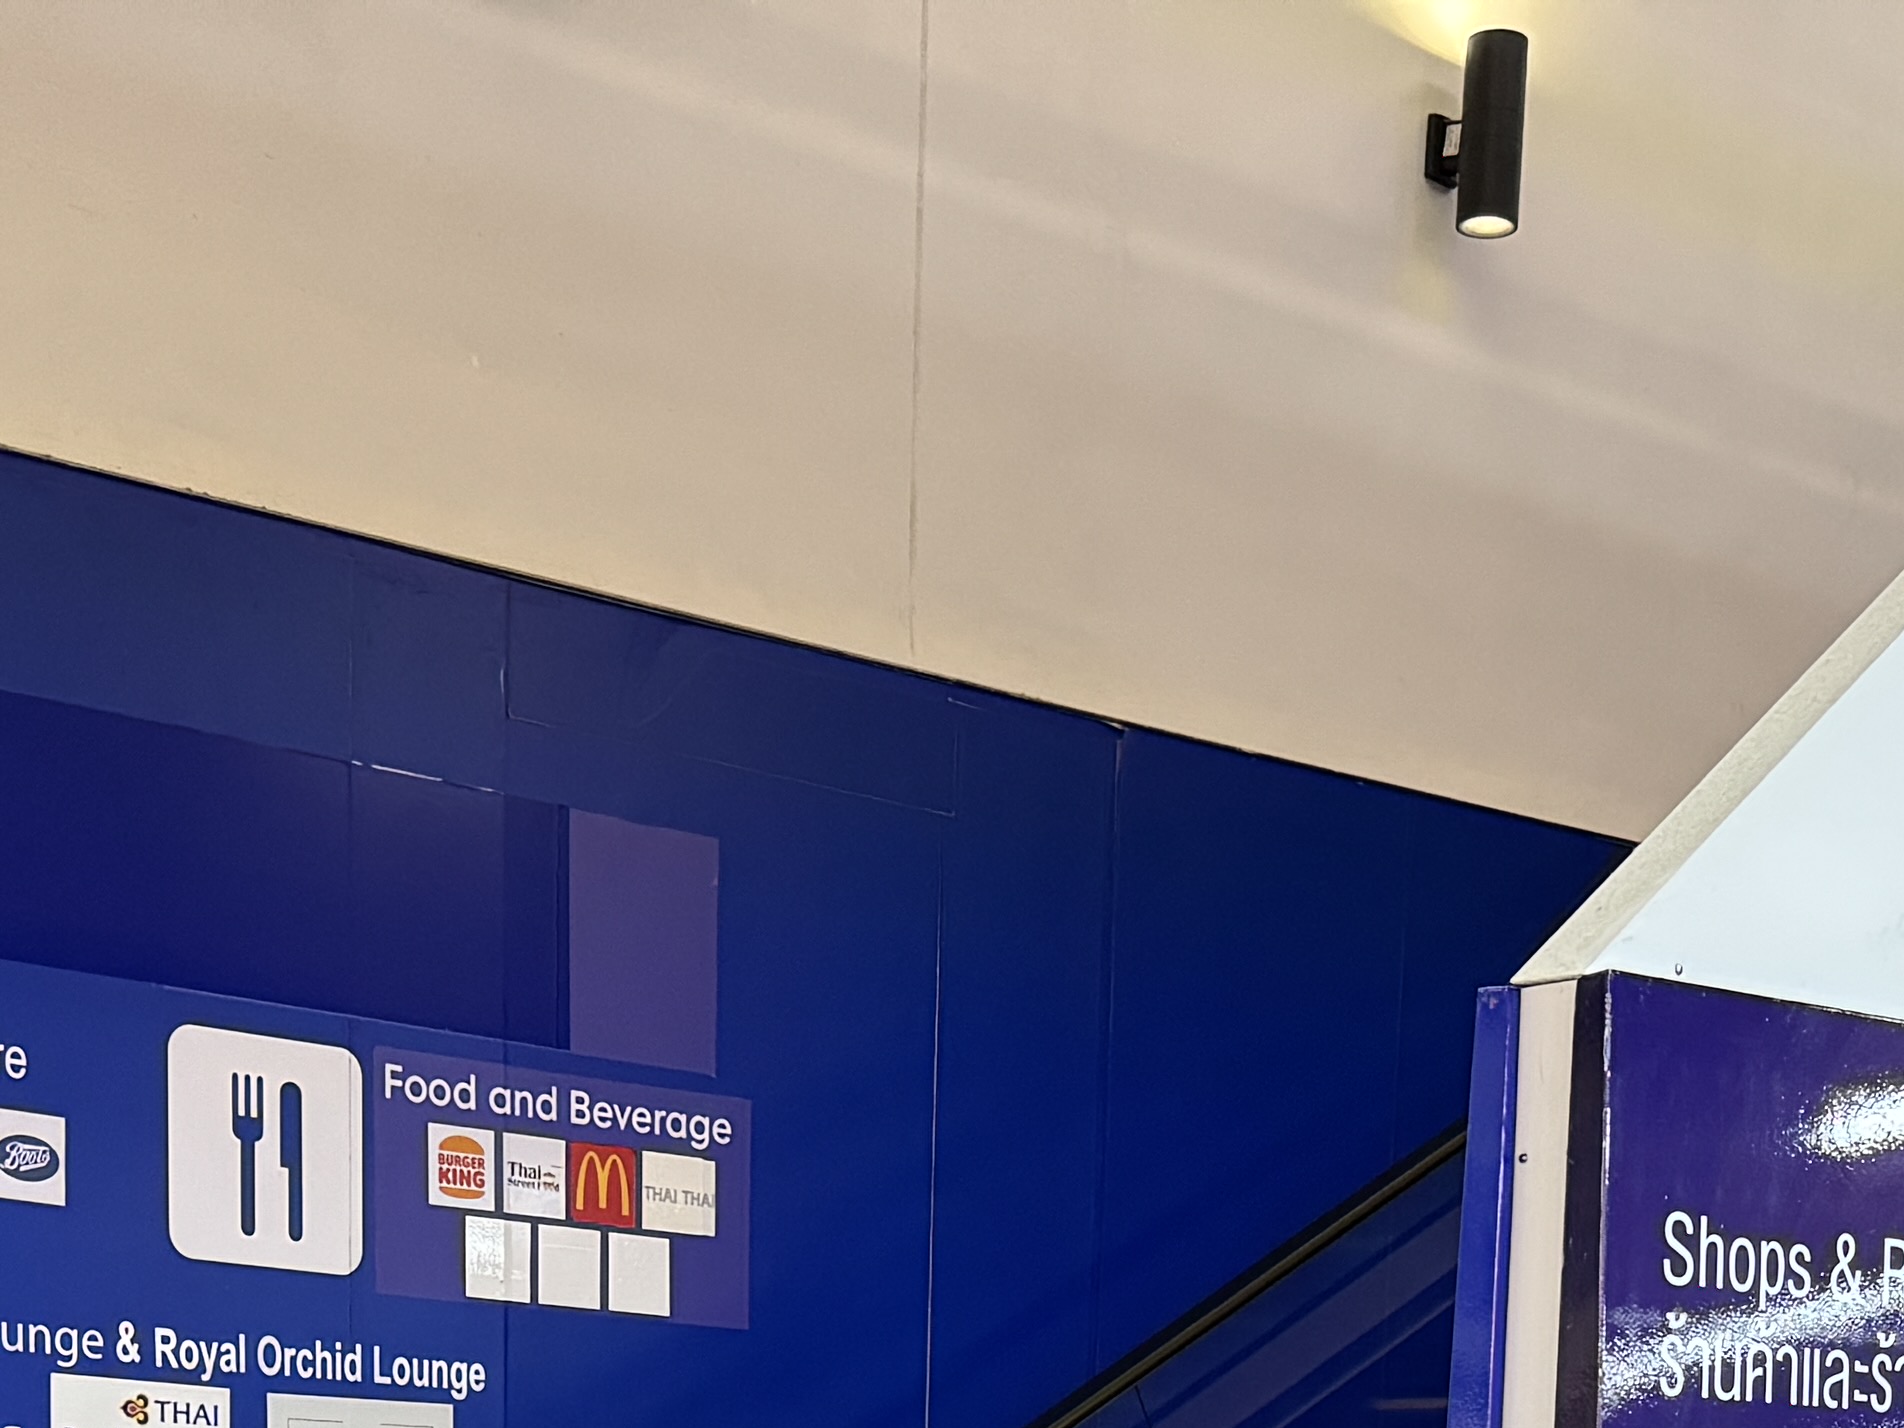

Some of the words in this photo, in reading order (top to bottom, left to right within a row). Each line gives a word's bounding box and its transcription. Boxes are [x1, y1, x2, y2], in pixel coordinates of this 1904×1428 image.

[385, 1063, 476, 1111] Food
[489, 1086, 558, 1122] and
[570, 1090, 733, 1150] Beverage
[0, 1141, 51, 1172] Boots
[438, 1152, 486, 1170] BURGER
[438, 1166, 486, 1189] KING
[645, 1185, 677, 1204] THAI
[1662, 1210, 1813, 1312] Shops
[1829, 1232, 1862, 1302] &
[116, 1320, 141, 1363] &
[155, 1327, 245, 1381] Royal
[257, 1335, 363, 1383] Orchid
[374, 1346, 486, 1399] Lounge
[154, 1399, 219, 1427] THAI
